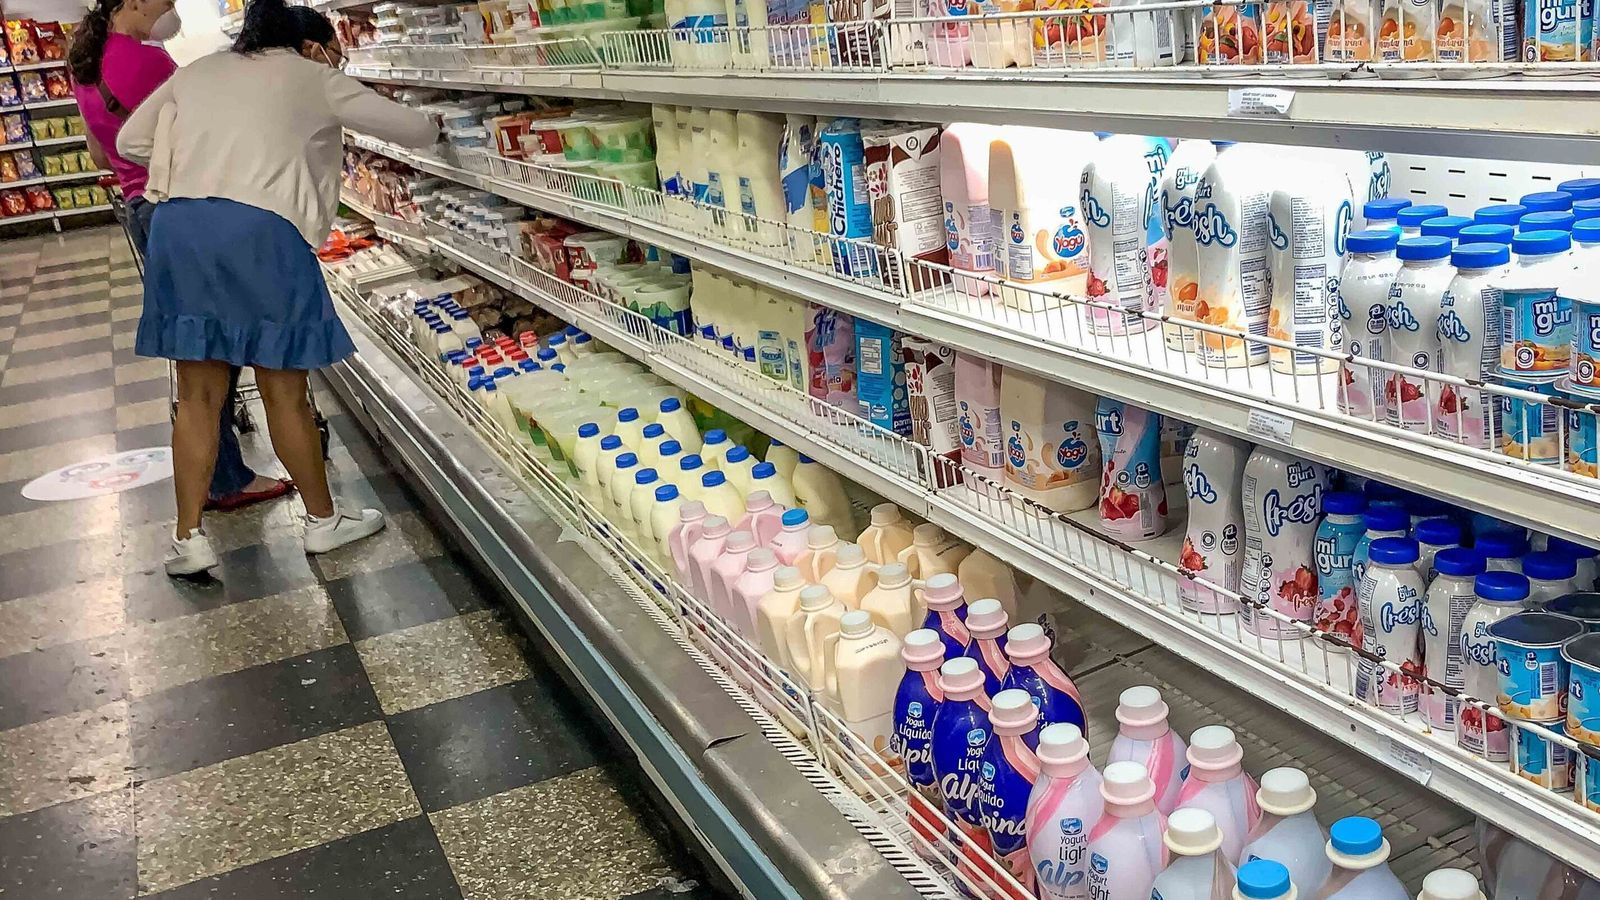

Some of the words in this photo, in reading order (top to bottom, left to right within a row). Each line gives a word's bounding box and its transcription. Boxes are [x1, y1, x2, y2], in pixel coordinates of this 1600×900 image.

[1175, 174, 1198, 190] gur
[1162, 192, 1195, 240] fre
[1535, 297, 1557, 314] mi
[1536, 308, 1573, 335] gur
[1288, 464, 1301, 474] mi
[1289, 470, 1315, 486] gurt
[1317, 539, 1336, 554] mi
[1317, 551, 1353, 574] gur
[1060, 834, 1087, 848] Yogurt
